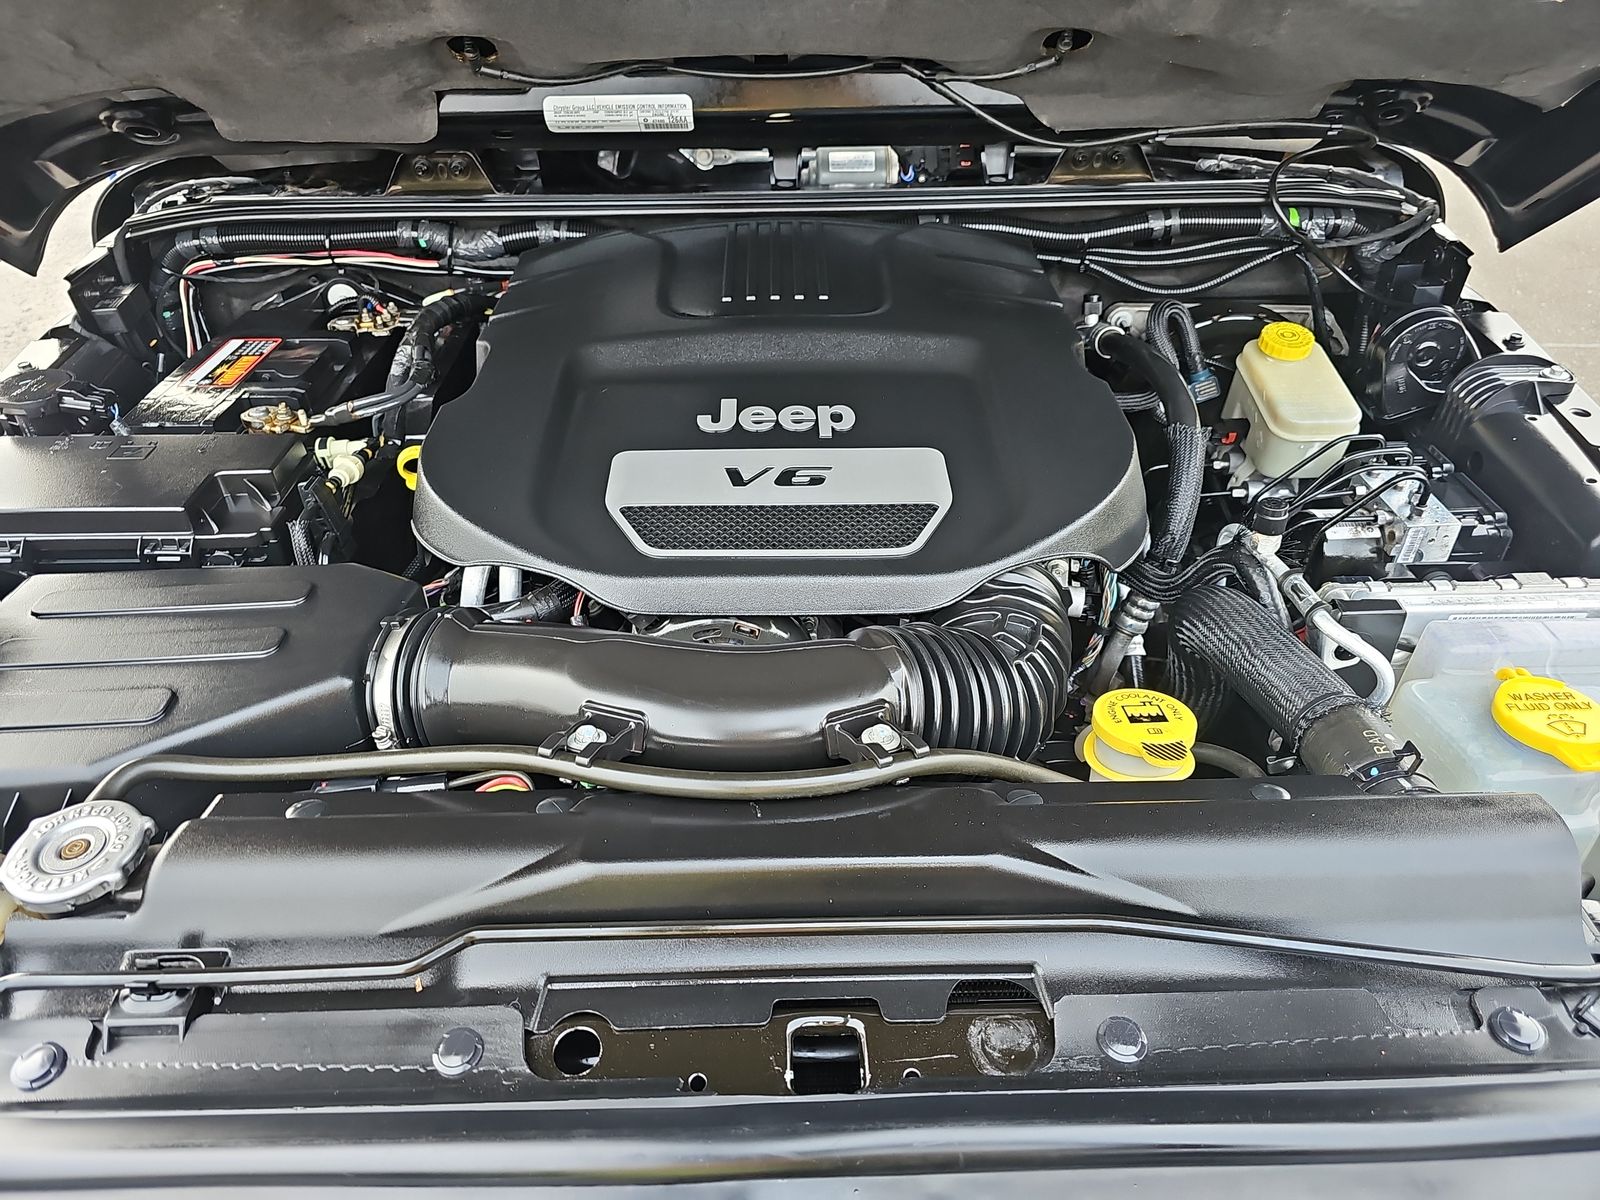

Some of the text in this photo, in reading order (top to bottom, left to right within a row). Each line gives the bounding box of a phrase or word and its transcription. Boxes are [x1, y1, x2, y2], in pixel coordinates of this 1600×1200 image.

[553, 104, 571, 112] Chrysler
[696, 398, 857, 438] Jeep
[723, 465, 834, 488] V6
[1505, 701, 1593, 712] FLUID ONLY
[1508, 691, 1576, 701] WASHER
[1107, 692, 1184, 724] ENGINE COOLANT ONLY
[1362, 729, 1390, 756] RAD
[69, 805, 114, 819] OPEN
[32, 815, 67, 840] HOT
